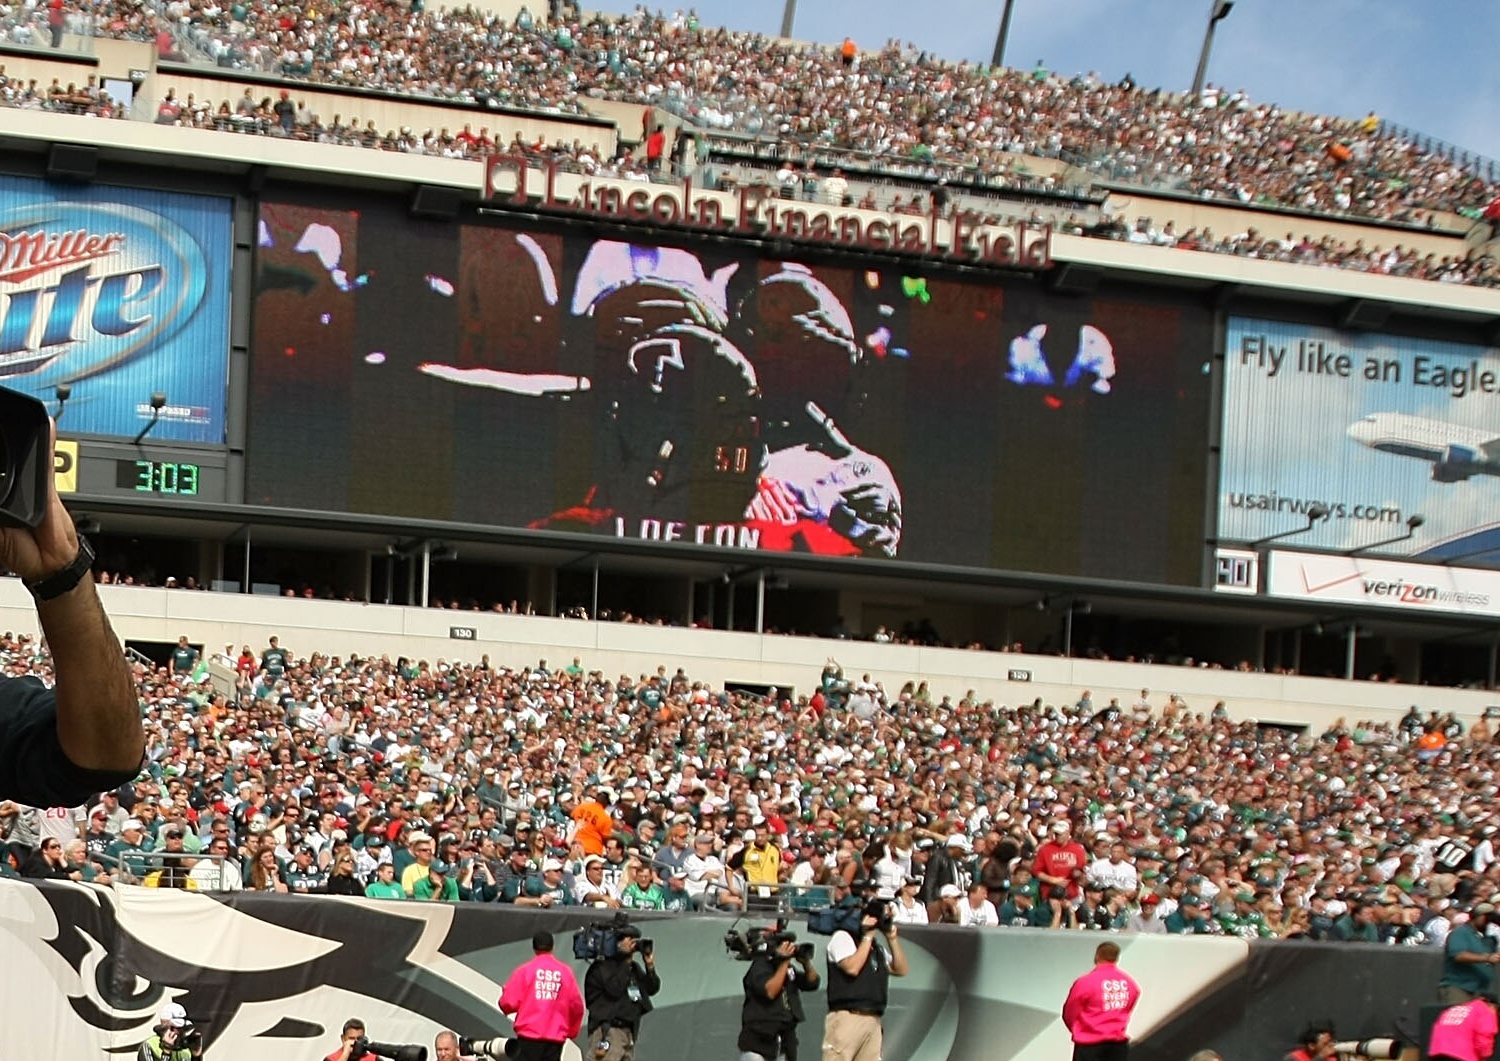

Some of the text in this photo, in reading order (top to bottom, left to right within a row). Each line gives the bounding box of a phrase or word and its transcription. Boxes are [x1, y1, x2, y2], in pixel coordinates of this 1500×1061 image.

[541, 157, 1055, 268] Lincoln Financial Field
[1241, 335, 1285, 378] Fly
[1298, 339, 1351, 378] like
[1363, 358, 1400, 384] an
[134, 459, 198, 495] 3:03
[1362, 578, 1491, 606] verizon wireless
[536, 968, 562, 982] CSC
[1103, 979, 1129, 991] CSC
